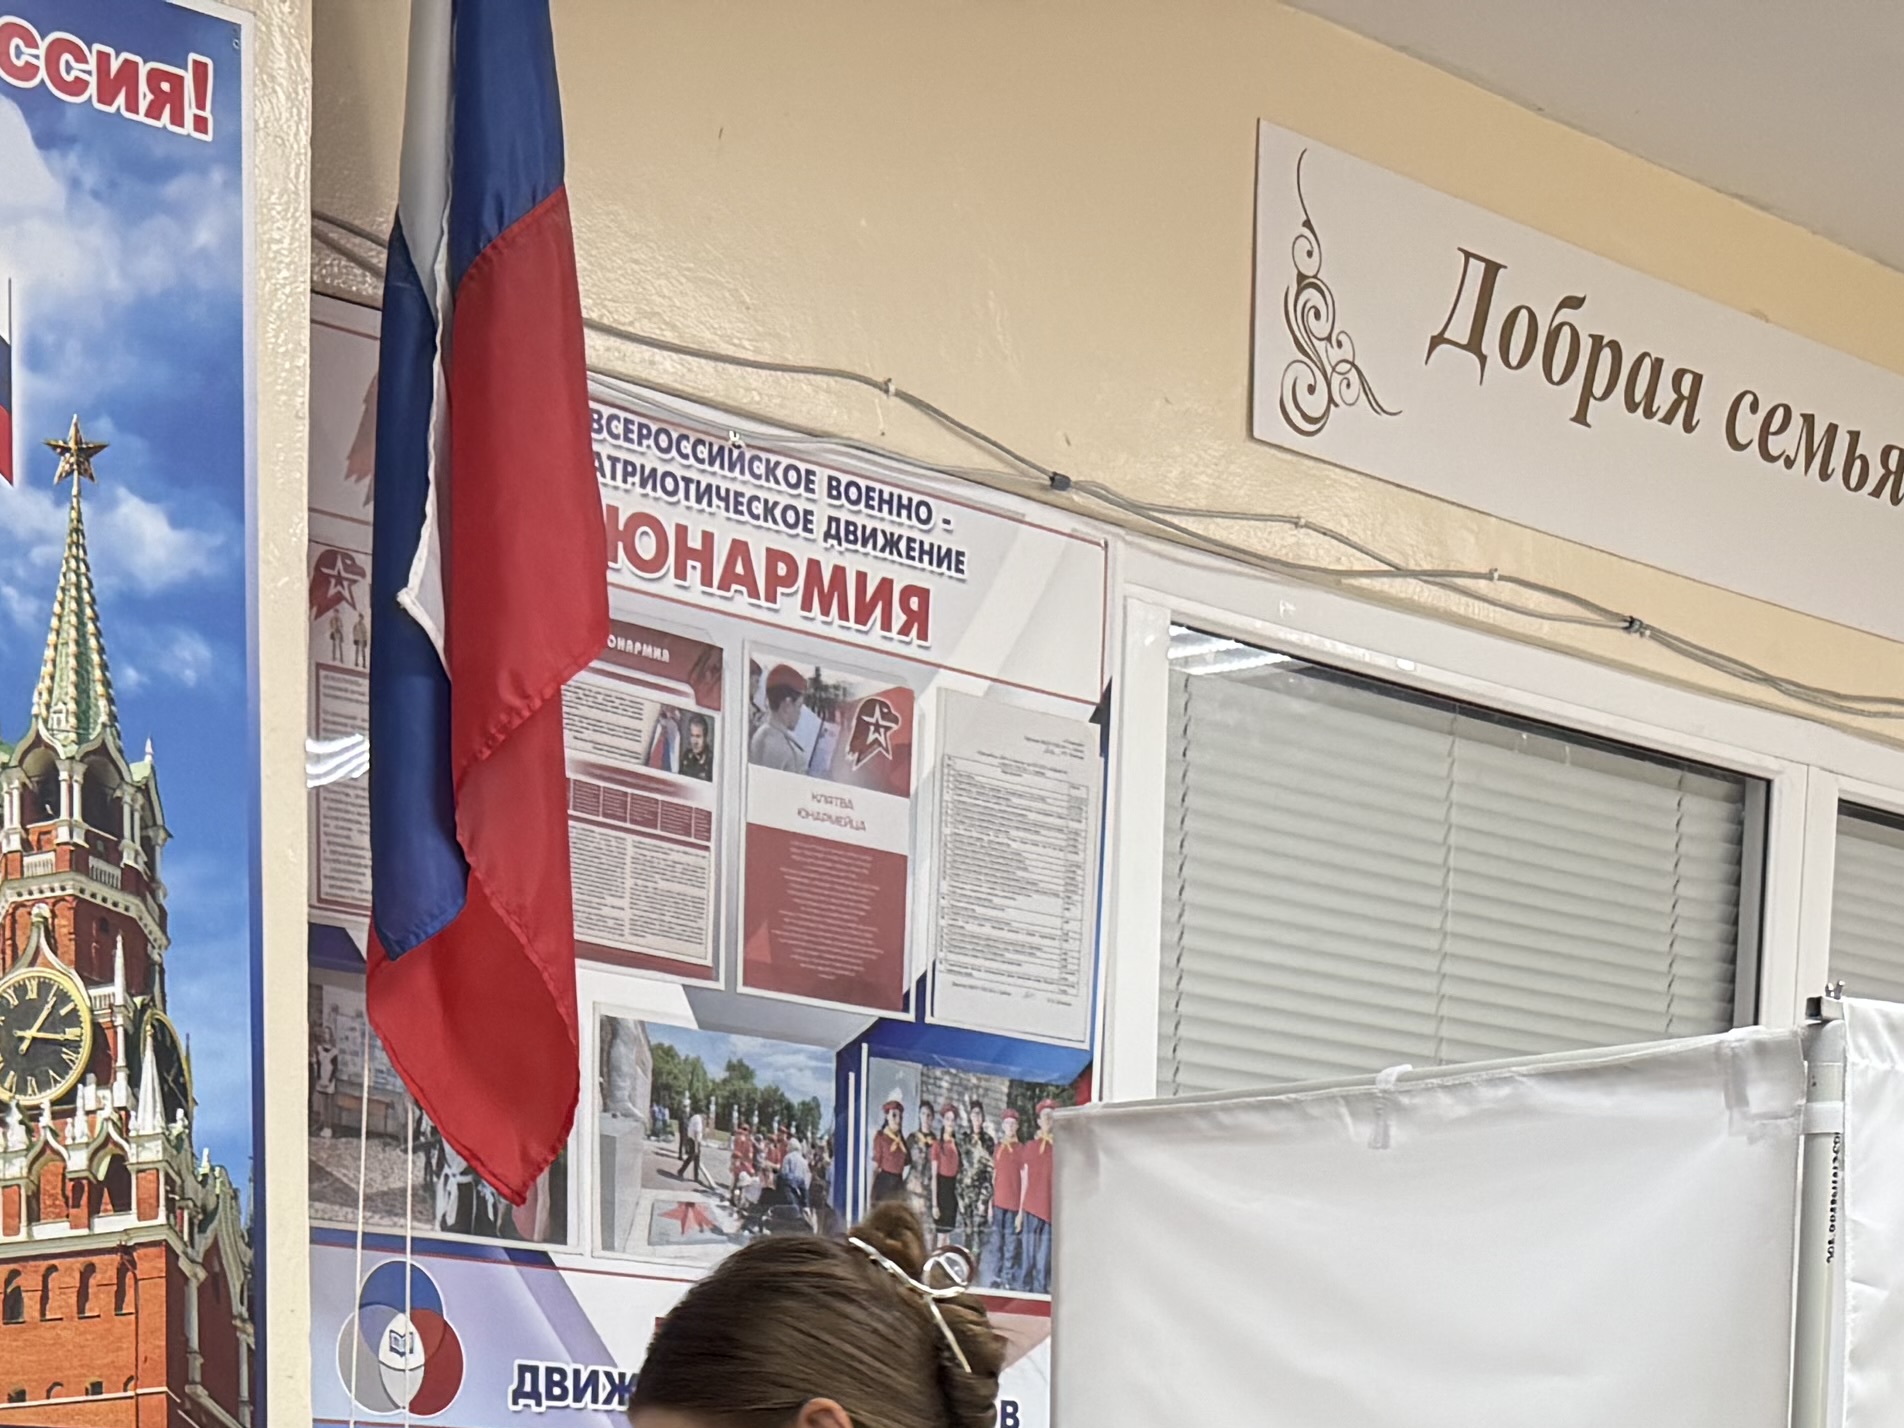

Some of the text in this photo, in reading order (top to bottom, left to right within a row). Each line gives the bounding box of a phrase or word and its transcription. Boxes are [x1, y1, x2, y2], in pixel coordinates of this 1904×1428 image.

[1424, 246, 1704, 433] Добрая
[591, 408, 817, 495] ВСЕРОССИЙСКОЕ
[827, 475, 933, 526] ВОЕННО
[607, 503, 931, 642] ЮНАРМИЯ
[823, 514, 966, 575] ДВИЖЕНИЕ
